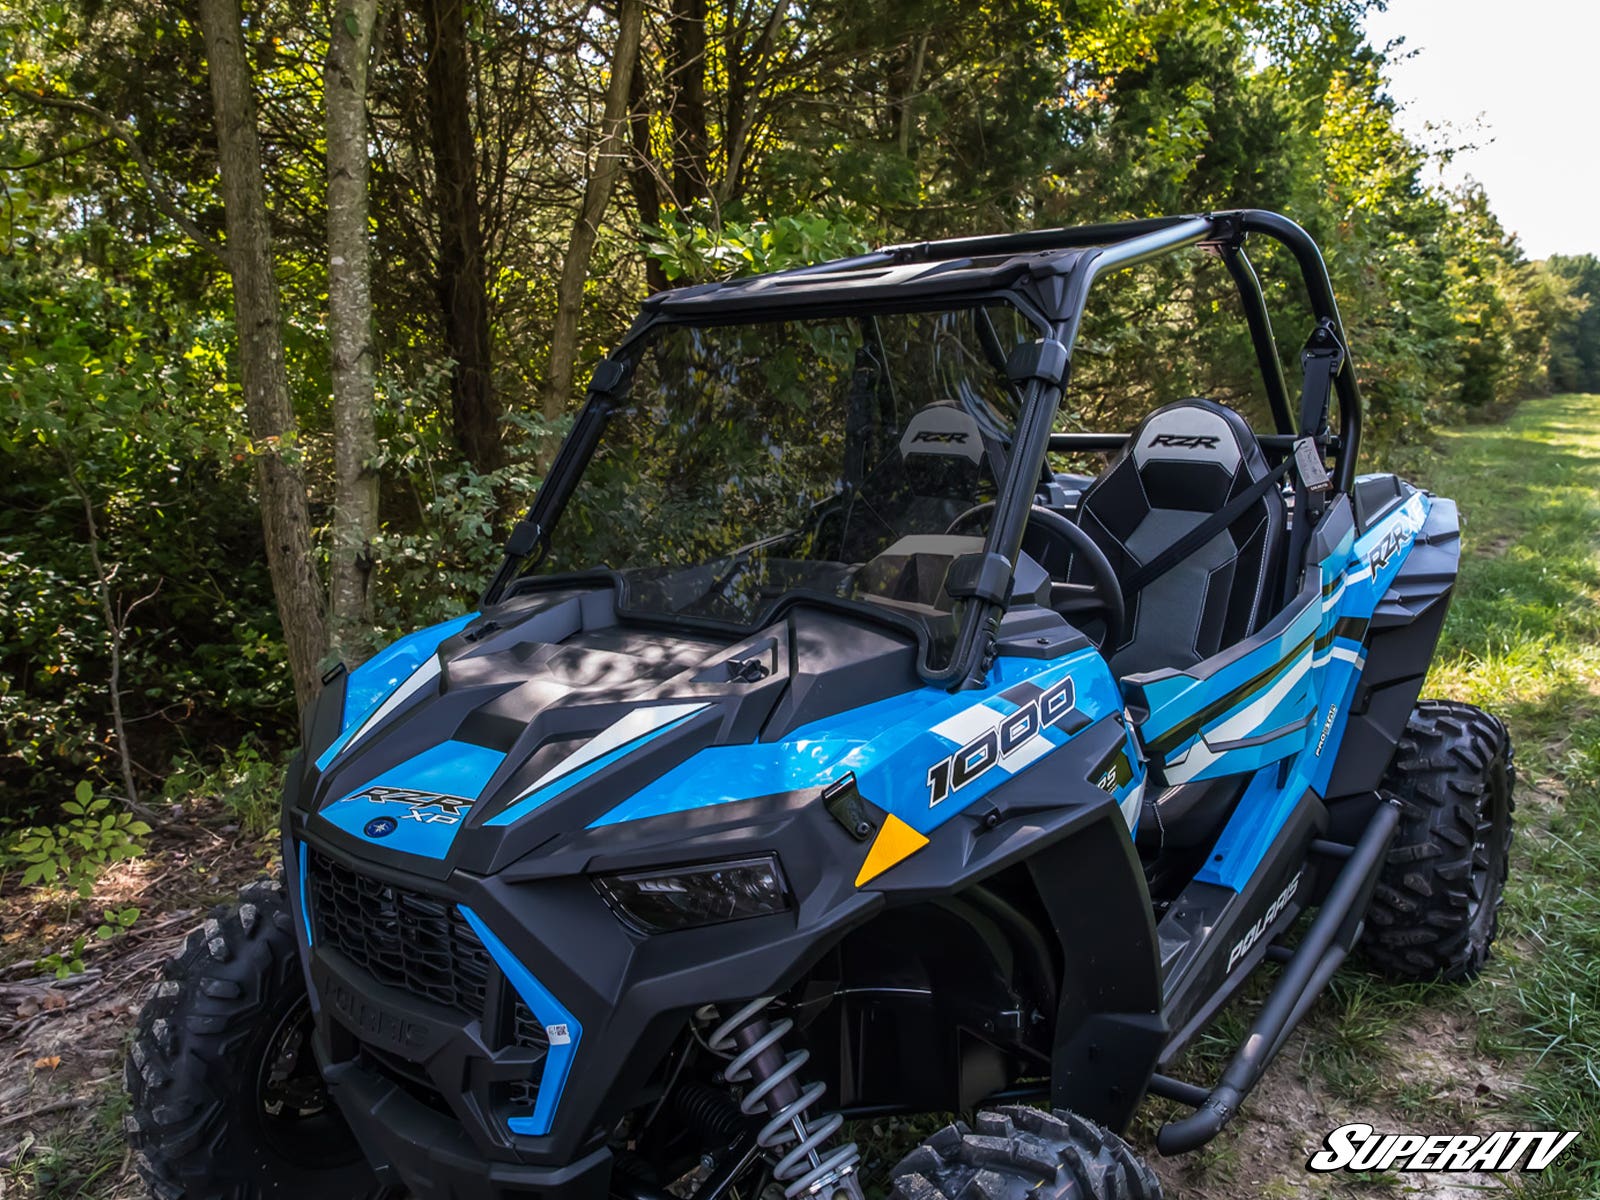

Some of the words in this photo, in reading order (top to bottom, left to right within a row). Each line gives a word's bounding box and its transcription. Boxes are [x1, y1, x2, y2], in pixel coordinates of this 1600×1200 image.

[911, 430, 970, 444] RZR
[1147, 434, 1221, 450] RZR
[1367, 519, 1412, 585] RZR
[926, 674, 1076, 809] 1000
[340, 785, 476, 816] RZR
[399, 809, 461, 825] XP
[1226, 871, 1303, 974] POLARIS
